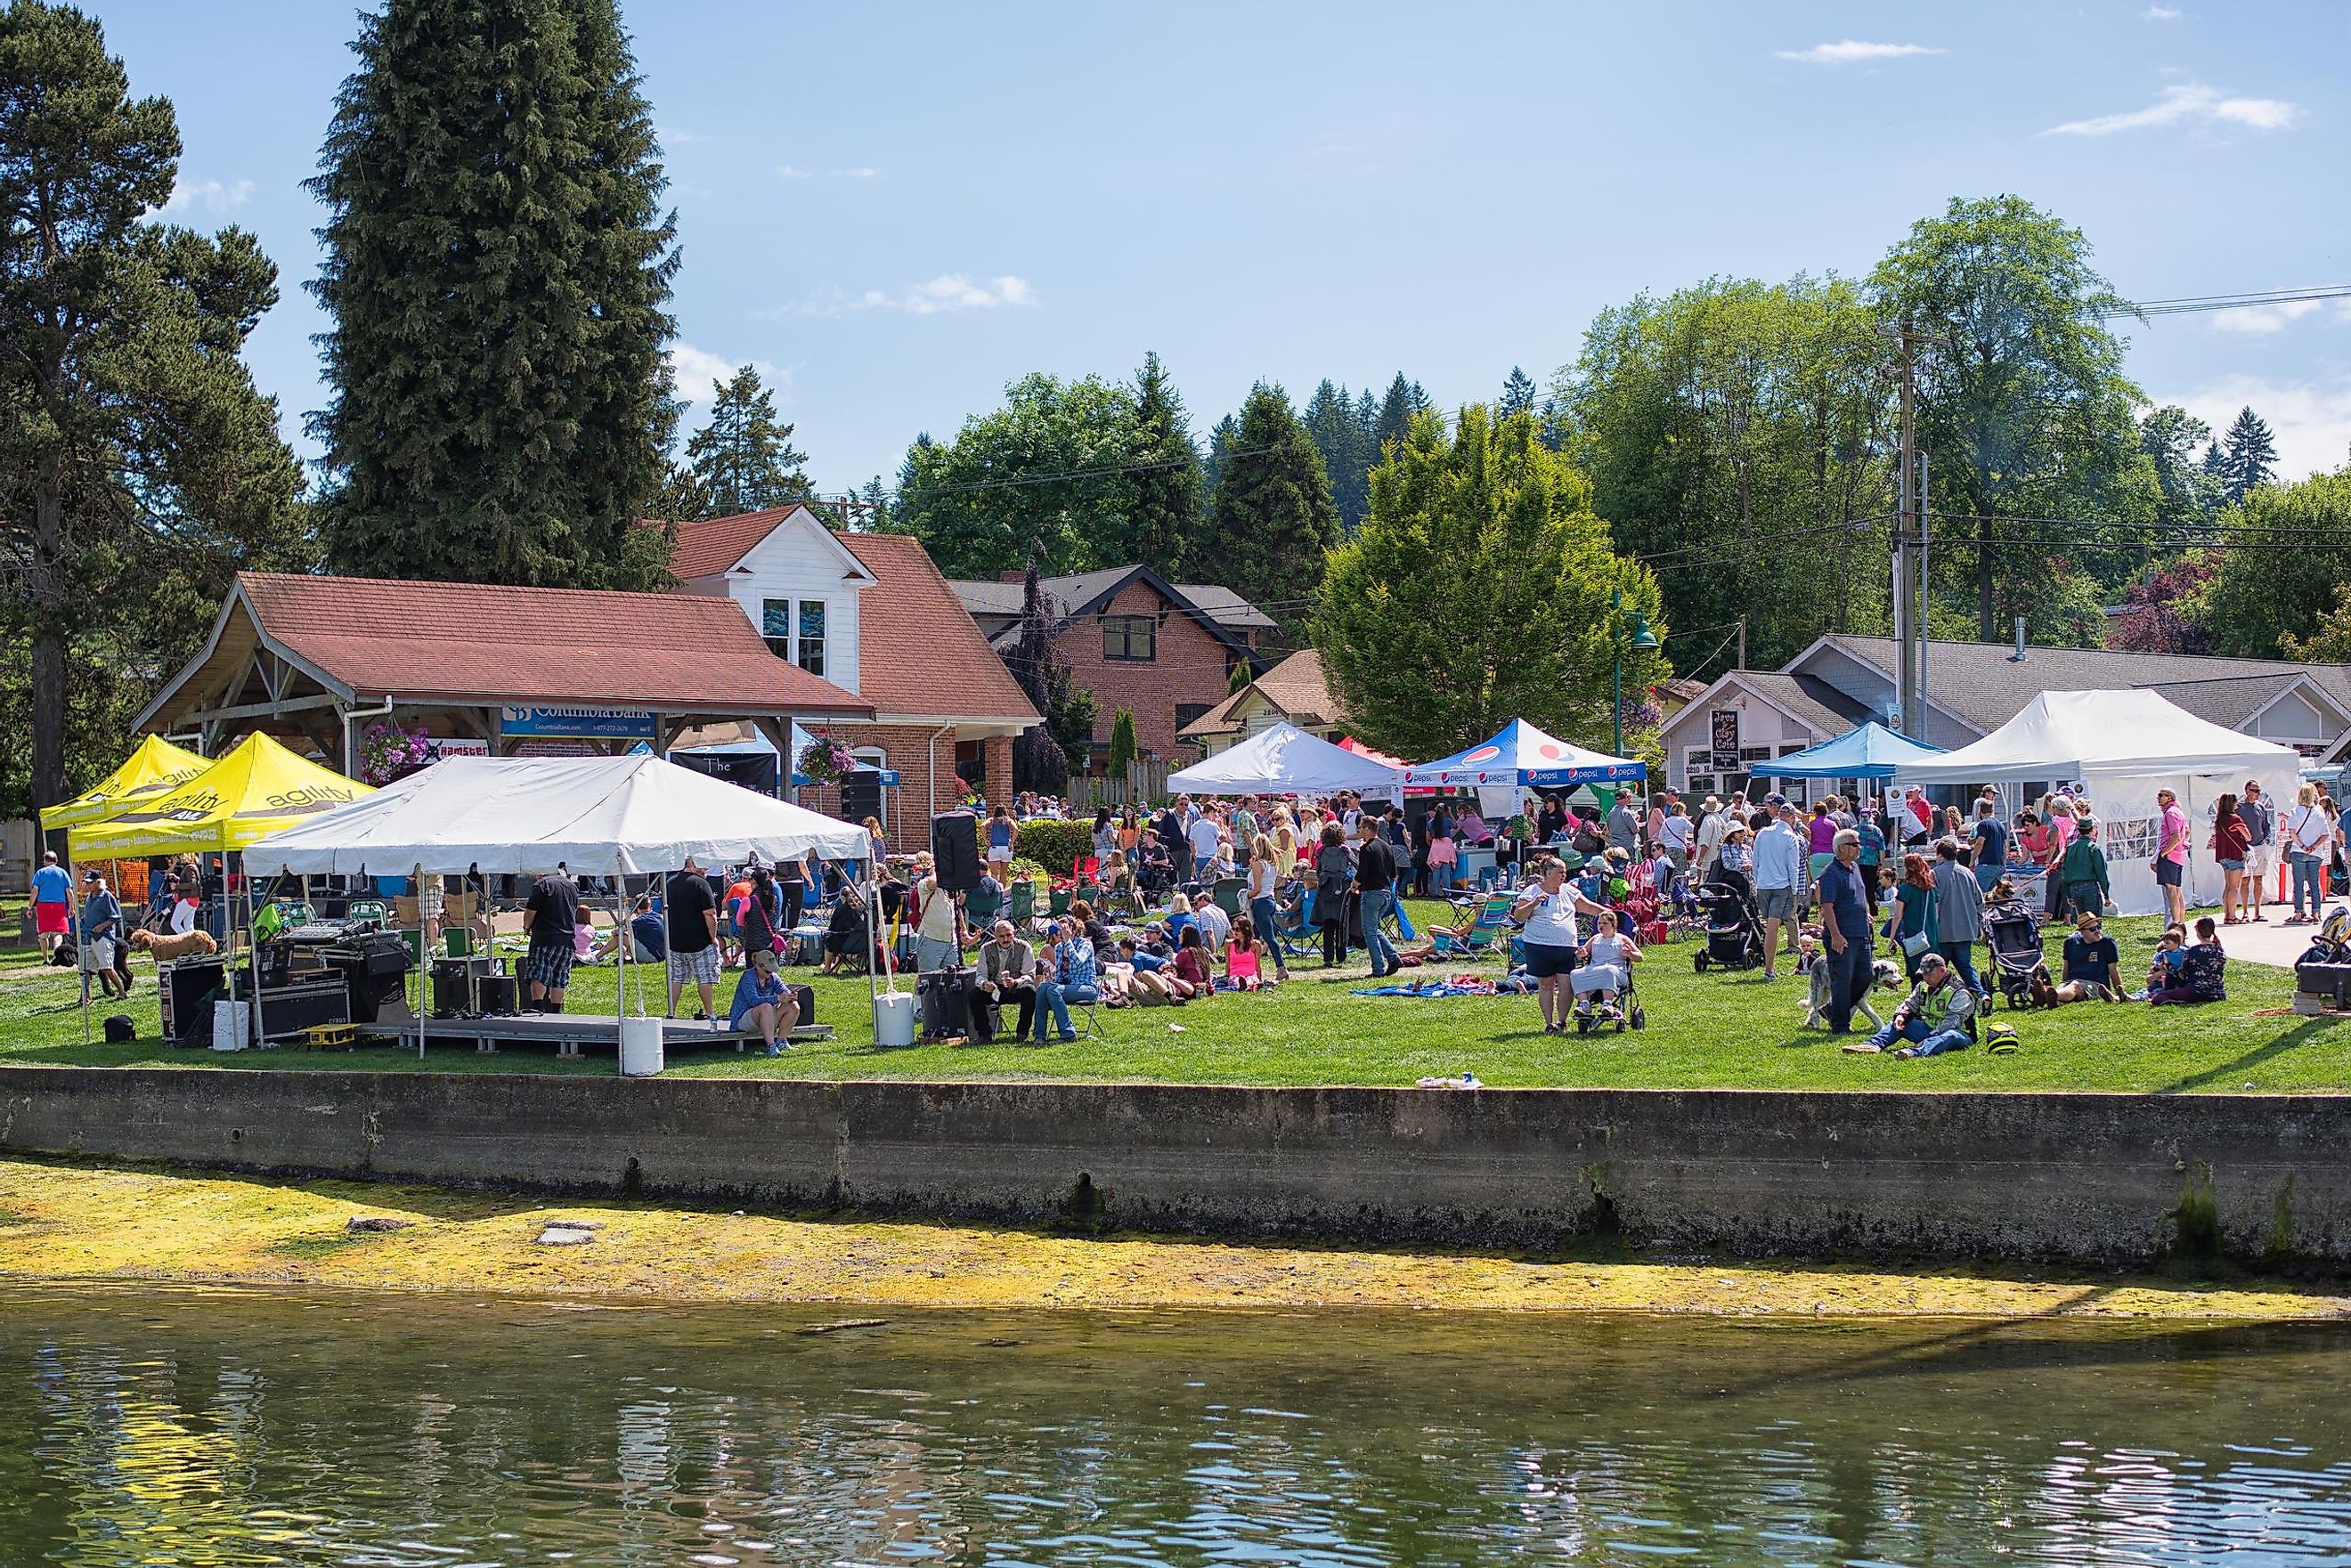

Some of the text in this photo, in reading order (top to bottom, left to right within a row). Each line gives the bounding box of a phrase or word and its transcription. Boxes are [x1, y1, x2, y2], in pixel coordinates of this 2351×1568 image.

[1714, 711, 1736, 722] Java
[1715, 727, 1736, 742] Clay
[1715, 738, 1736, 749] Cafe
[704, 758, 731, 773] The
[1618, 766, 1637, 776] pepsi
[1413, 774, 1432, 783] pepsi
[1450, 774, 1468, 783] pepsi
[1488, 773, 1508, 783] pepsi
[1538, 771, 1558, 781] pepsi
[1578, 768, 1598, 779] pepsi
[265, 784, 354, 806] agility
[159, 791, 230, 812] agility
